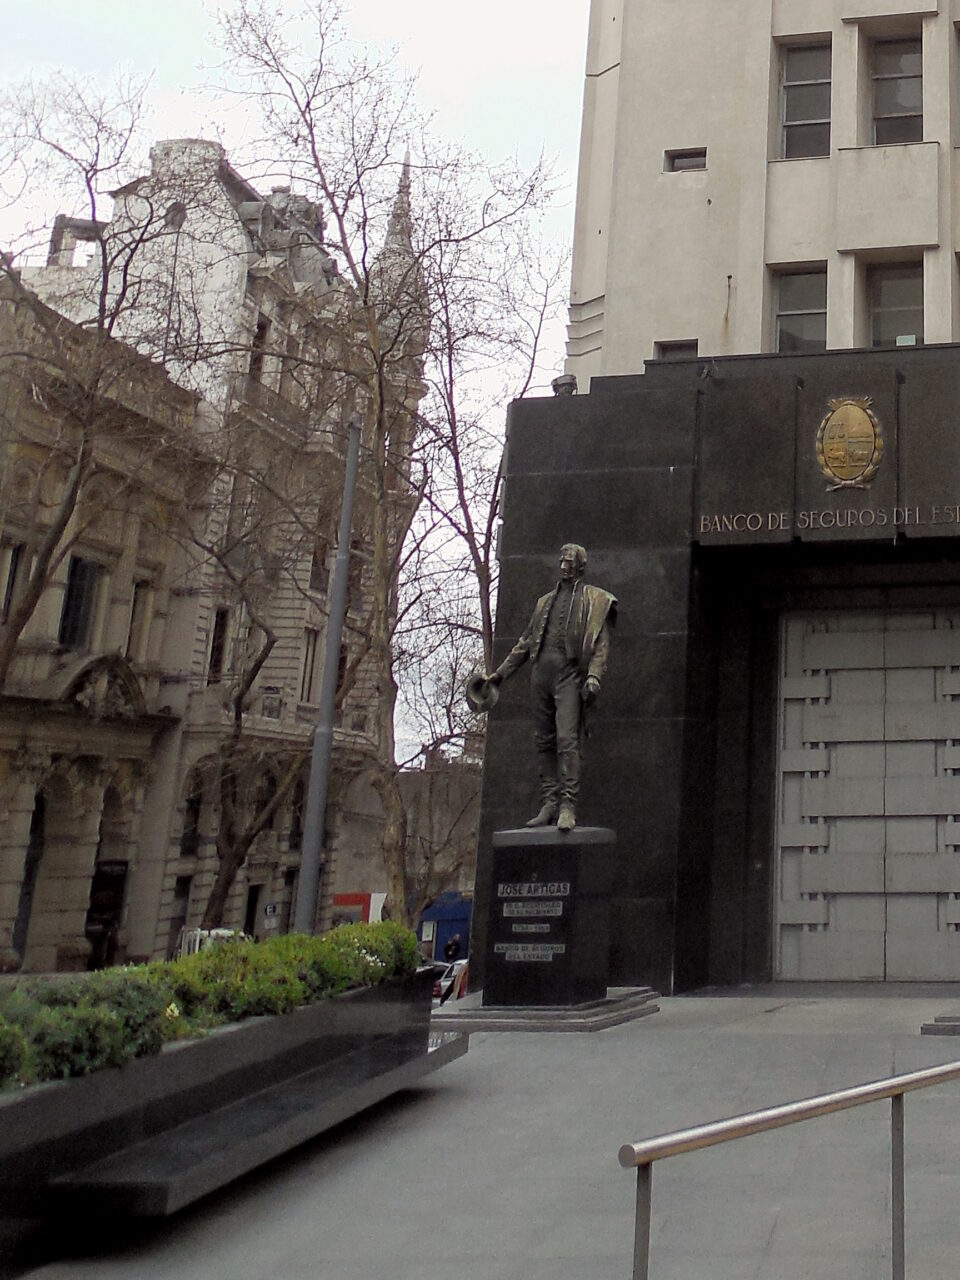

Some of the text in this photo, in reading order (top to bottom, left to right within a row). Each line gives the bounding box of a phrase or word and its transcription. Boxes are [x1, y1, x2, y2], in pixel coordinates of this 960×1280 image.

[700, 512, 763, 533] BANCO
[767, 511, 790, 531] DE
[797, 508, 888, 529] SEGUROS
[893, 506, 926, 526] DEL
[527, 882, 568, 895] ARTIGAS
